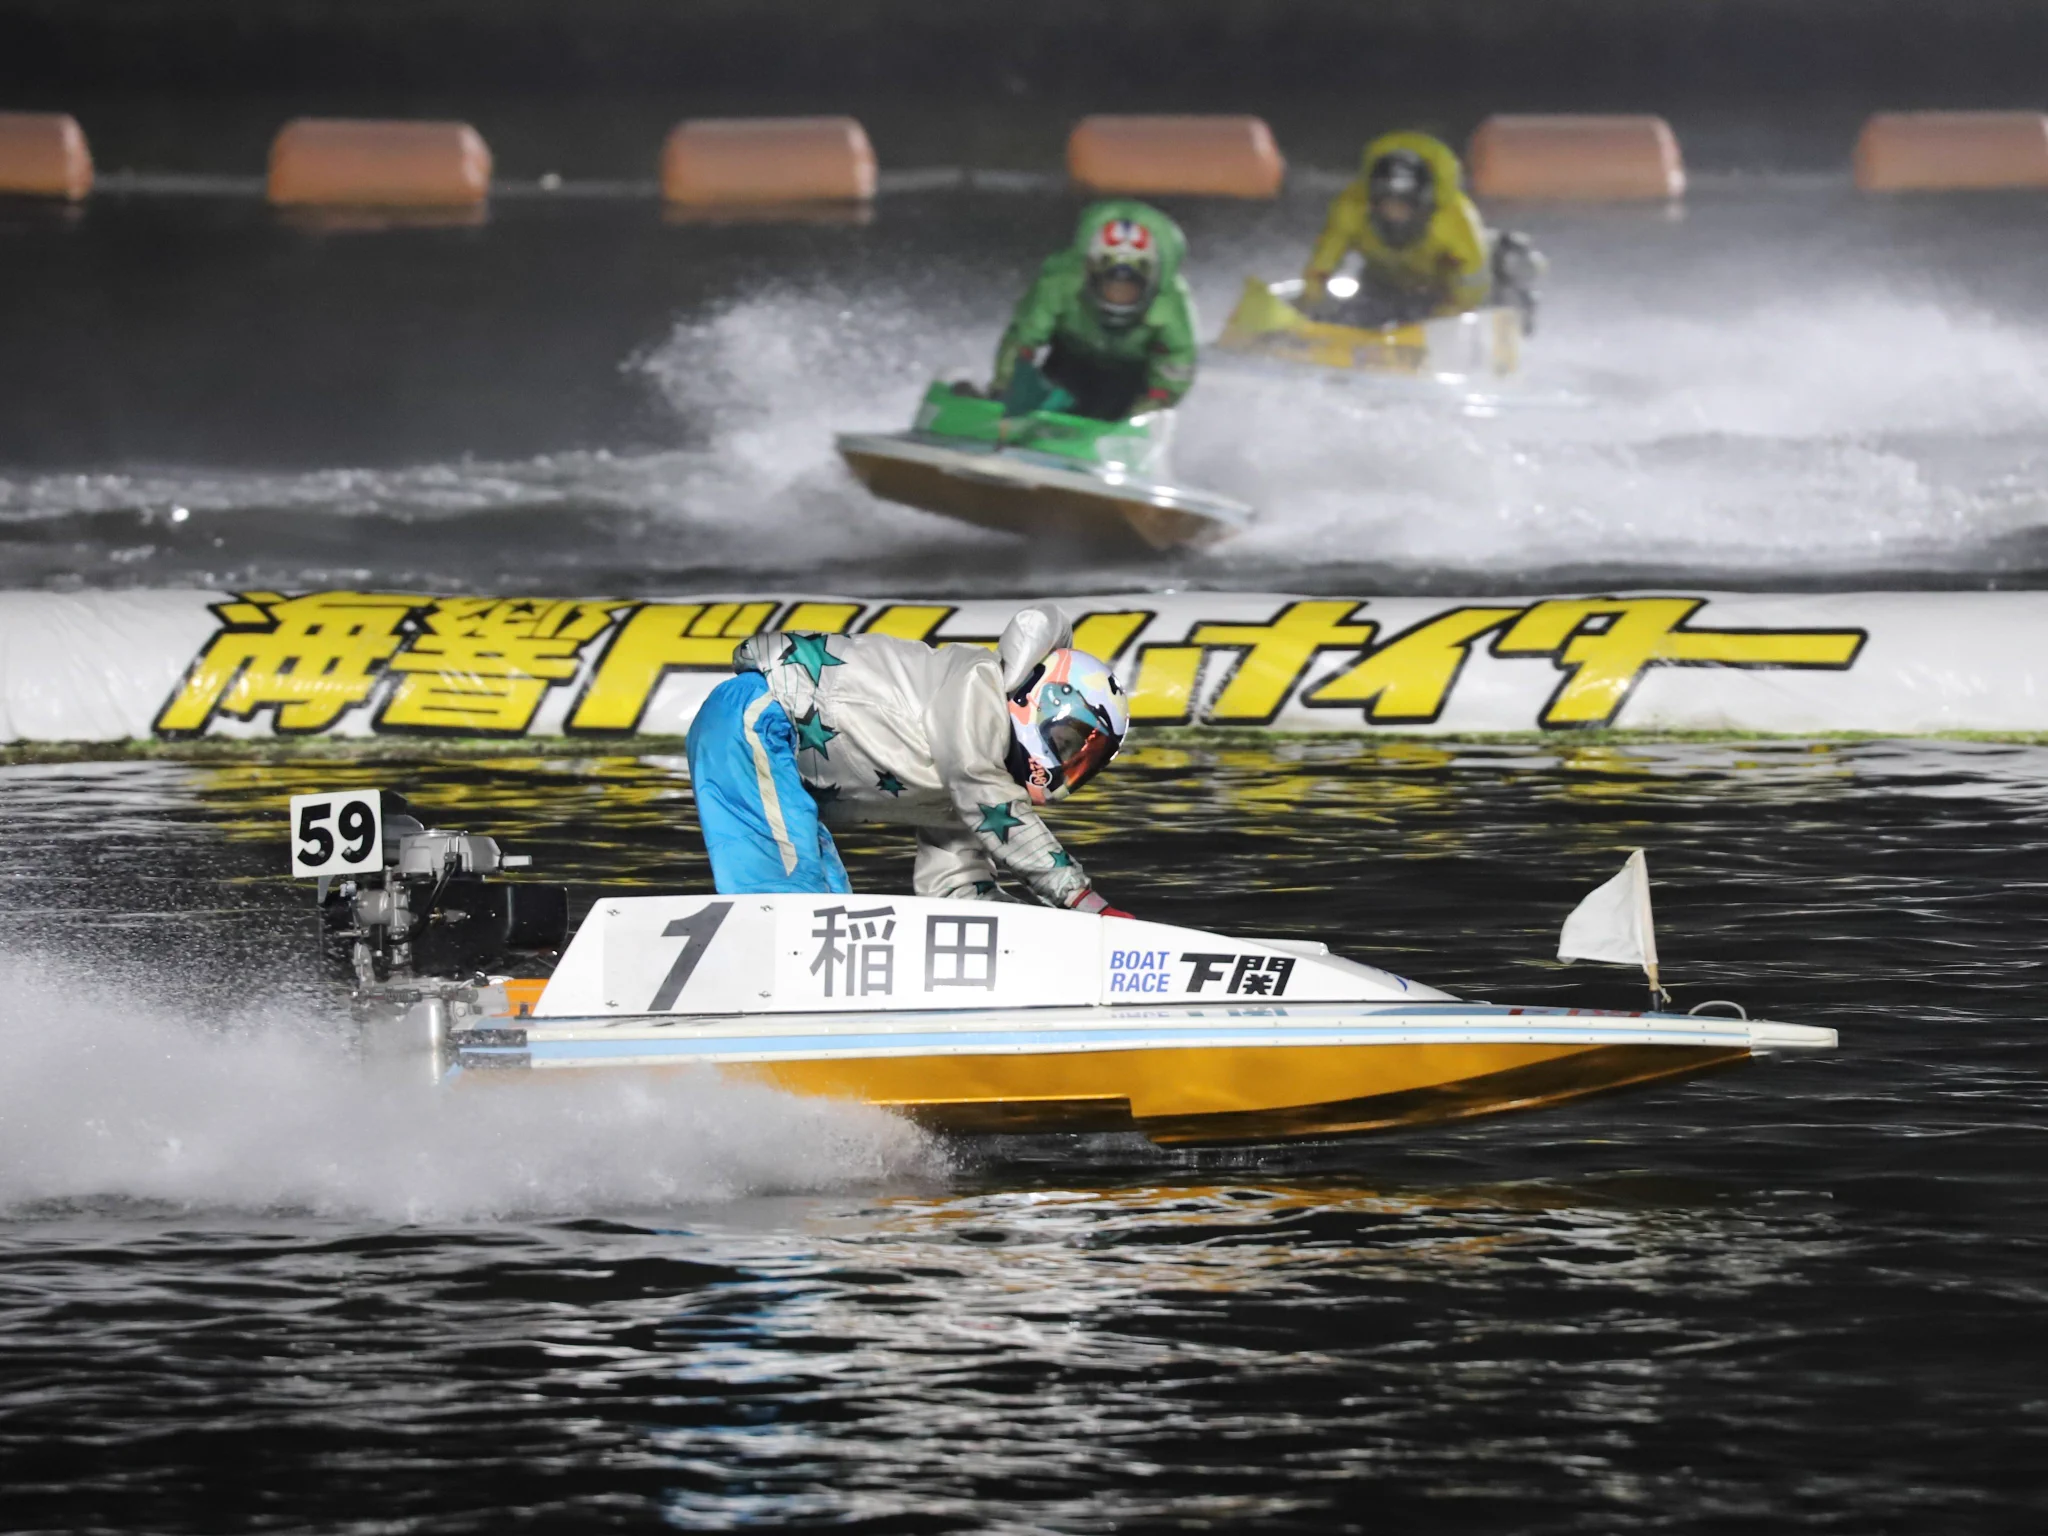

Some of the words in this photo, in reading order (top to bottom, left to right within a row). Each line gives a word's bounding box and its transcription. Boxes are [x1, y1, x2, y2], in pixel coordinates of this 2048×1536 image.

[297, 800, 376, 867] 59
[647, 901, 736, 1012] 1
[809, 905, 999, 998] 稲田
[1109, 950, 1171, 970] BOAT
[1179, 952, 1297, 997] 下関
[1109, 973, 1171, 993] RACE
